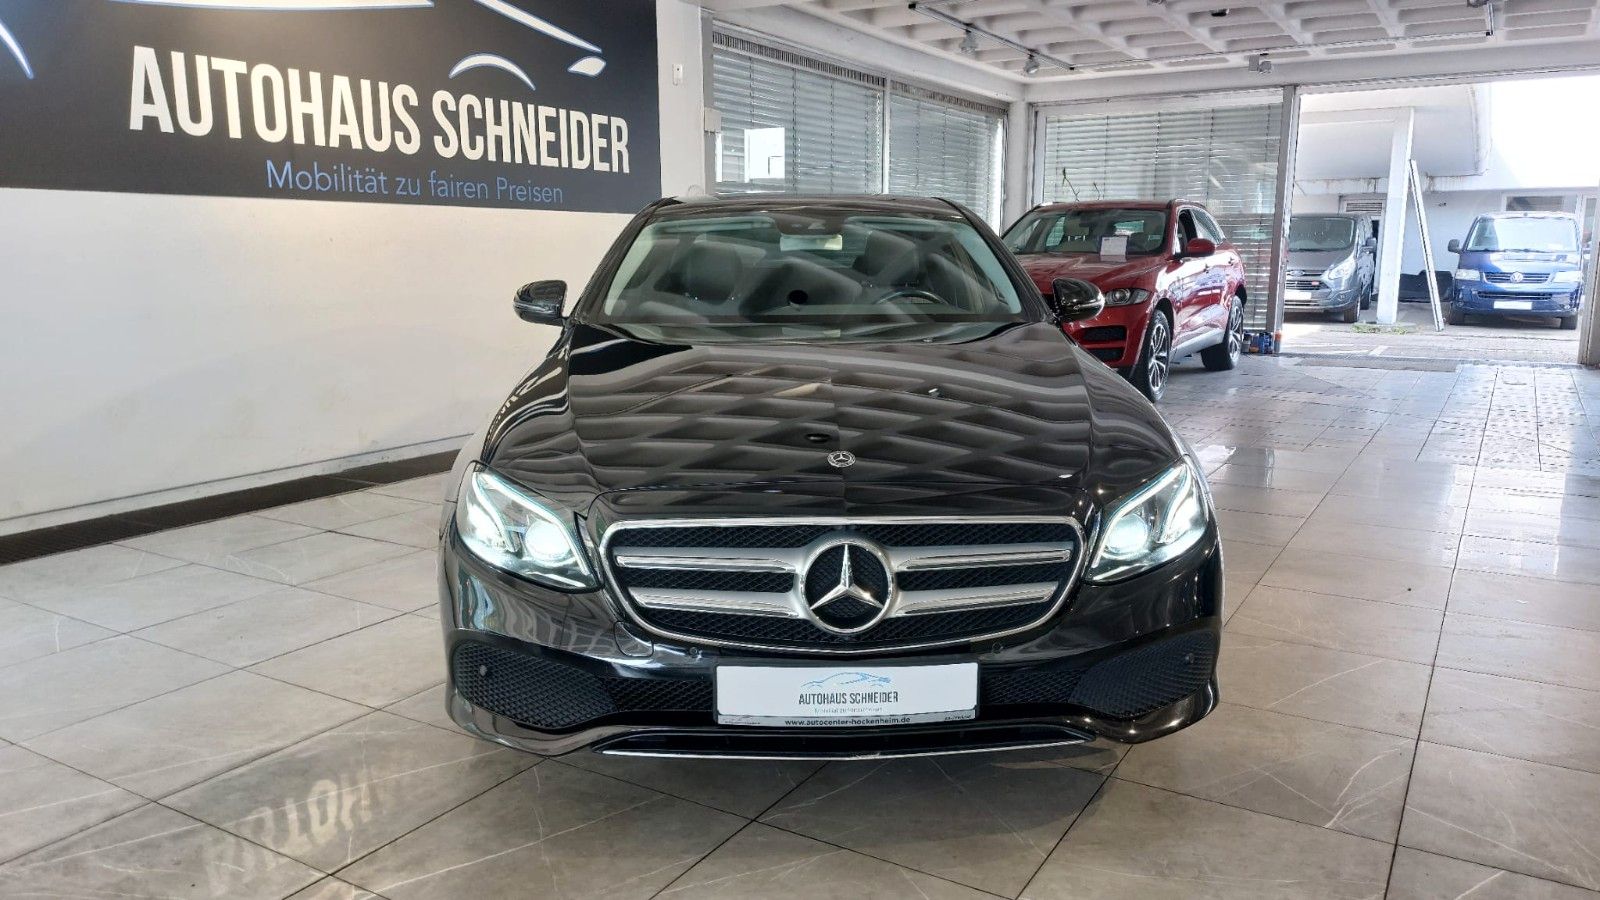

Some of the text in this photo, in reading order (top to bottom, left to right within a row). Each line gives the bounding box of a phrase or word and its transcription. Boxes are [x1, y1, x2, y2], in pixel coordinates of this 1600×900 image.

[129, 45, 630, 174] AUTOHAUS SCHNEIDER
[266, 160, 563, 203] Mobilität zu fairen Preisen
[798, 691, 899, 705] AUTOHAUS SCHNEIDER
[784, 715, 911, 726] www.autocenter-hockenheim.de
